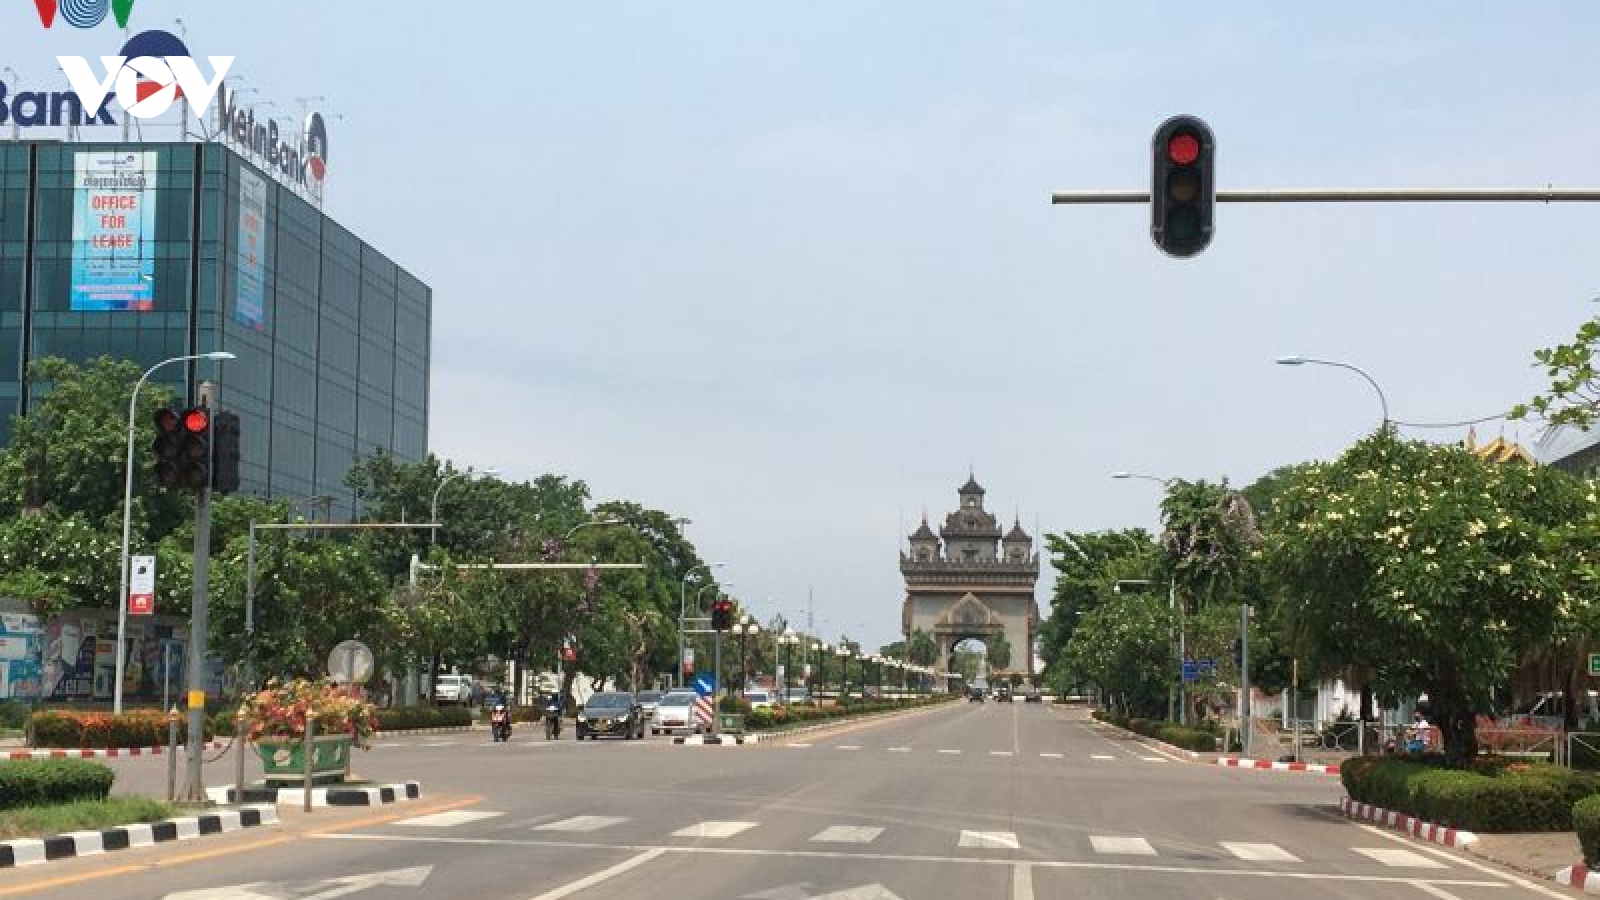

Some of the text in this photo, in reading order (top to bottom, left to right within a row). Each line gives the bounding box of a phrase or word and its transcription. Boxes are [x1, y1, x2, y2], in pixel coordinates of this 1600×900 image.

[91, 195, 137, 211] OFFICE
[101, 214, 126, 229] FOR
[92, 234, 133, 249] LEASE
